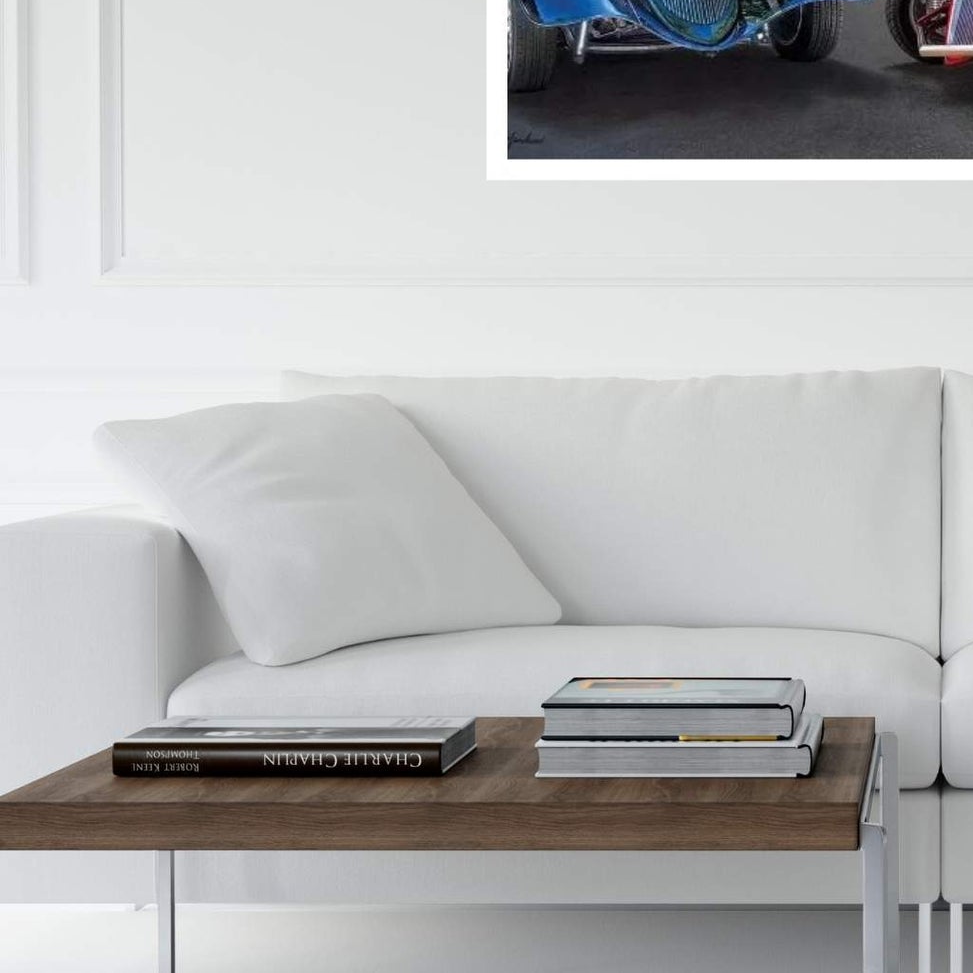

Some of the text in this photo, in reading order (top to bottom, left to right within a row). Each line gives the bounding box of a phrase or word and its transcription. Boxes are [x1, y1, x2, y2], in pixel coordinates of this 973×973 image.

[145, 749, 201, 760] THOMPSON
[263, 752, 423, 768] CHARLIE CHAPLIN
[163, 762, 200, 773] ROBERT
